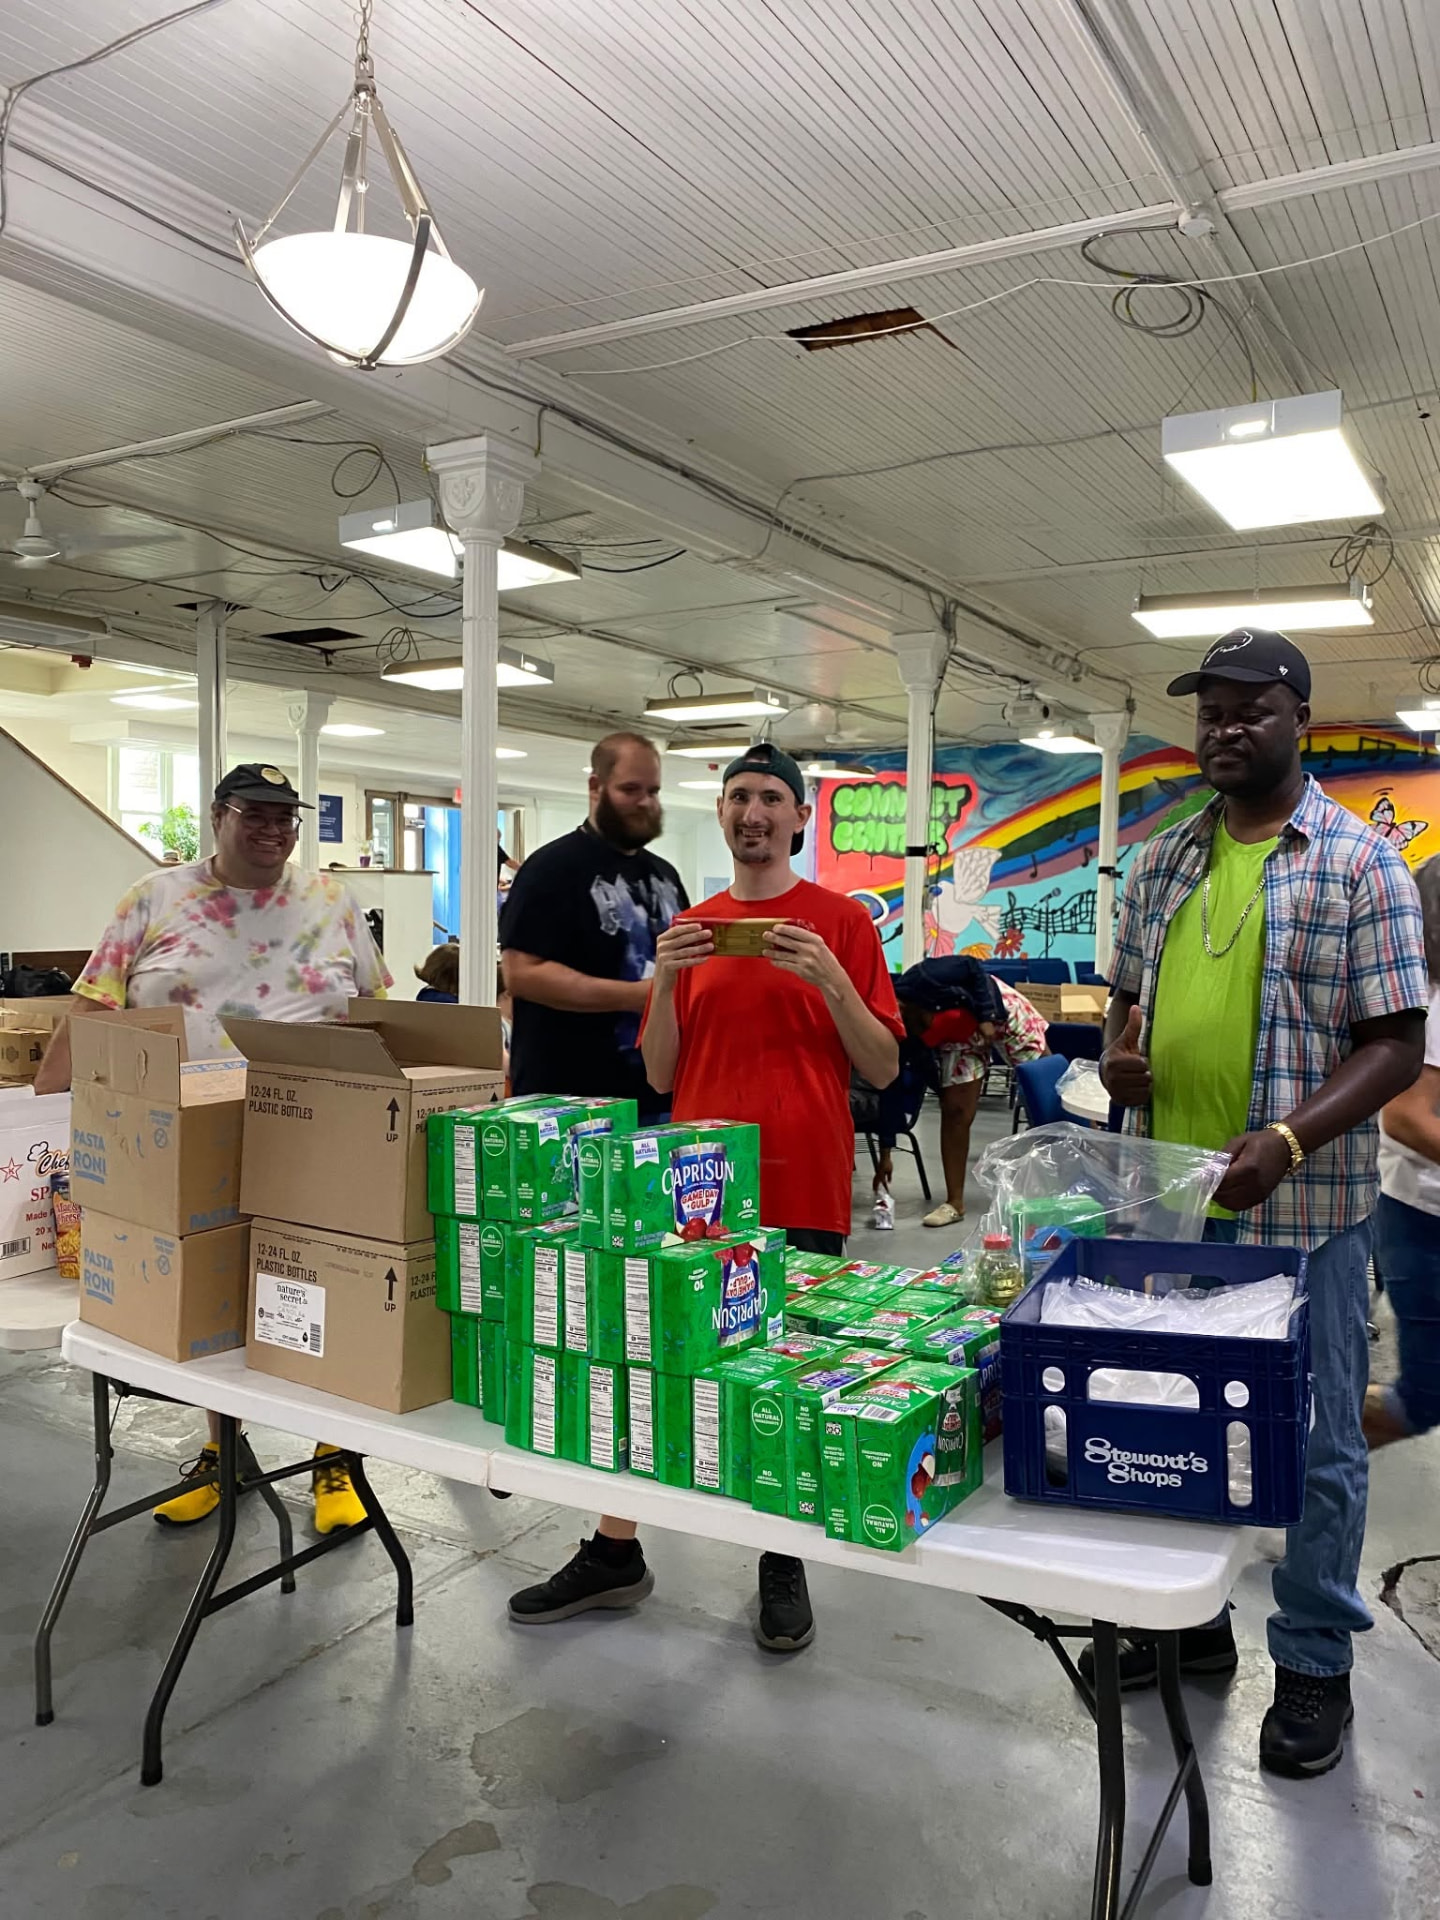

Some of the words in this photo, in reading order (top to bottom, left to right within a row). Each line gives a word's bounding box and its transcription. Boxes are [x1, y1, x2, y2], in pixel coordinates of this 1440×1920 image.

[833, 784, 966, 817] CONNCT
[832, 820, 948, 856] CENTR
[250, 1085, 271, 1098] 12-24
[249, 1101, 279, 1116] PLASTIC
[281, 1104, 313, 1120] BOTTLES
[73, 1128, 106, 1151] PASTA
[386, 1133, 399, 1143] UP
[635, 1147, 657, 1155] NATURAL
[73, 1150, 107, 1173] RONI
[681, 1190, 703, 1204] GAME
[705, 1189, 720, 1199] DAY
[690, 1199, 710, 1210] GULP
[742, 1199, 753, 1208] 10
[26, 1210, 48, 1222] Made
[35, 1226, 46, 1236] 20
[257, 1243, 277, 1257] 12-24
[279, 1248, 290, 1261] FL.
[291, 1250, 302, 1264] OZ.
[84, 1248, 114, 1273] PASTA
[256, 1260, 285, 1276] PLASTIC
[287, 1265, 317, 1283] BOTTLES
[84, 1269, 115, 1296] RONI
[693, 1280, 705, 1291] 10
[277, 1284, 306, 1297] nature's
[280, 1293, 302, 1305] secret
[384, 1302, 396, 1312] UP
[754, 1412, 780, 1421] NATURAL
[1084, 1437, 1208, 1473] Stewart's
[1107, 1462, 1182, 1487] Shops
[866, 1519, 895, 1530] NATURAL
